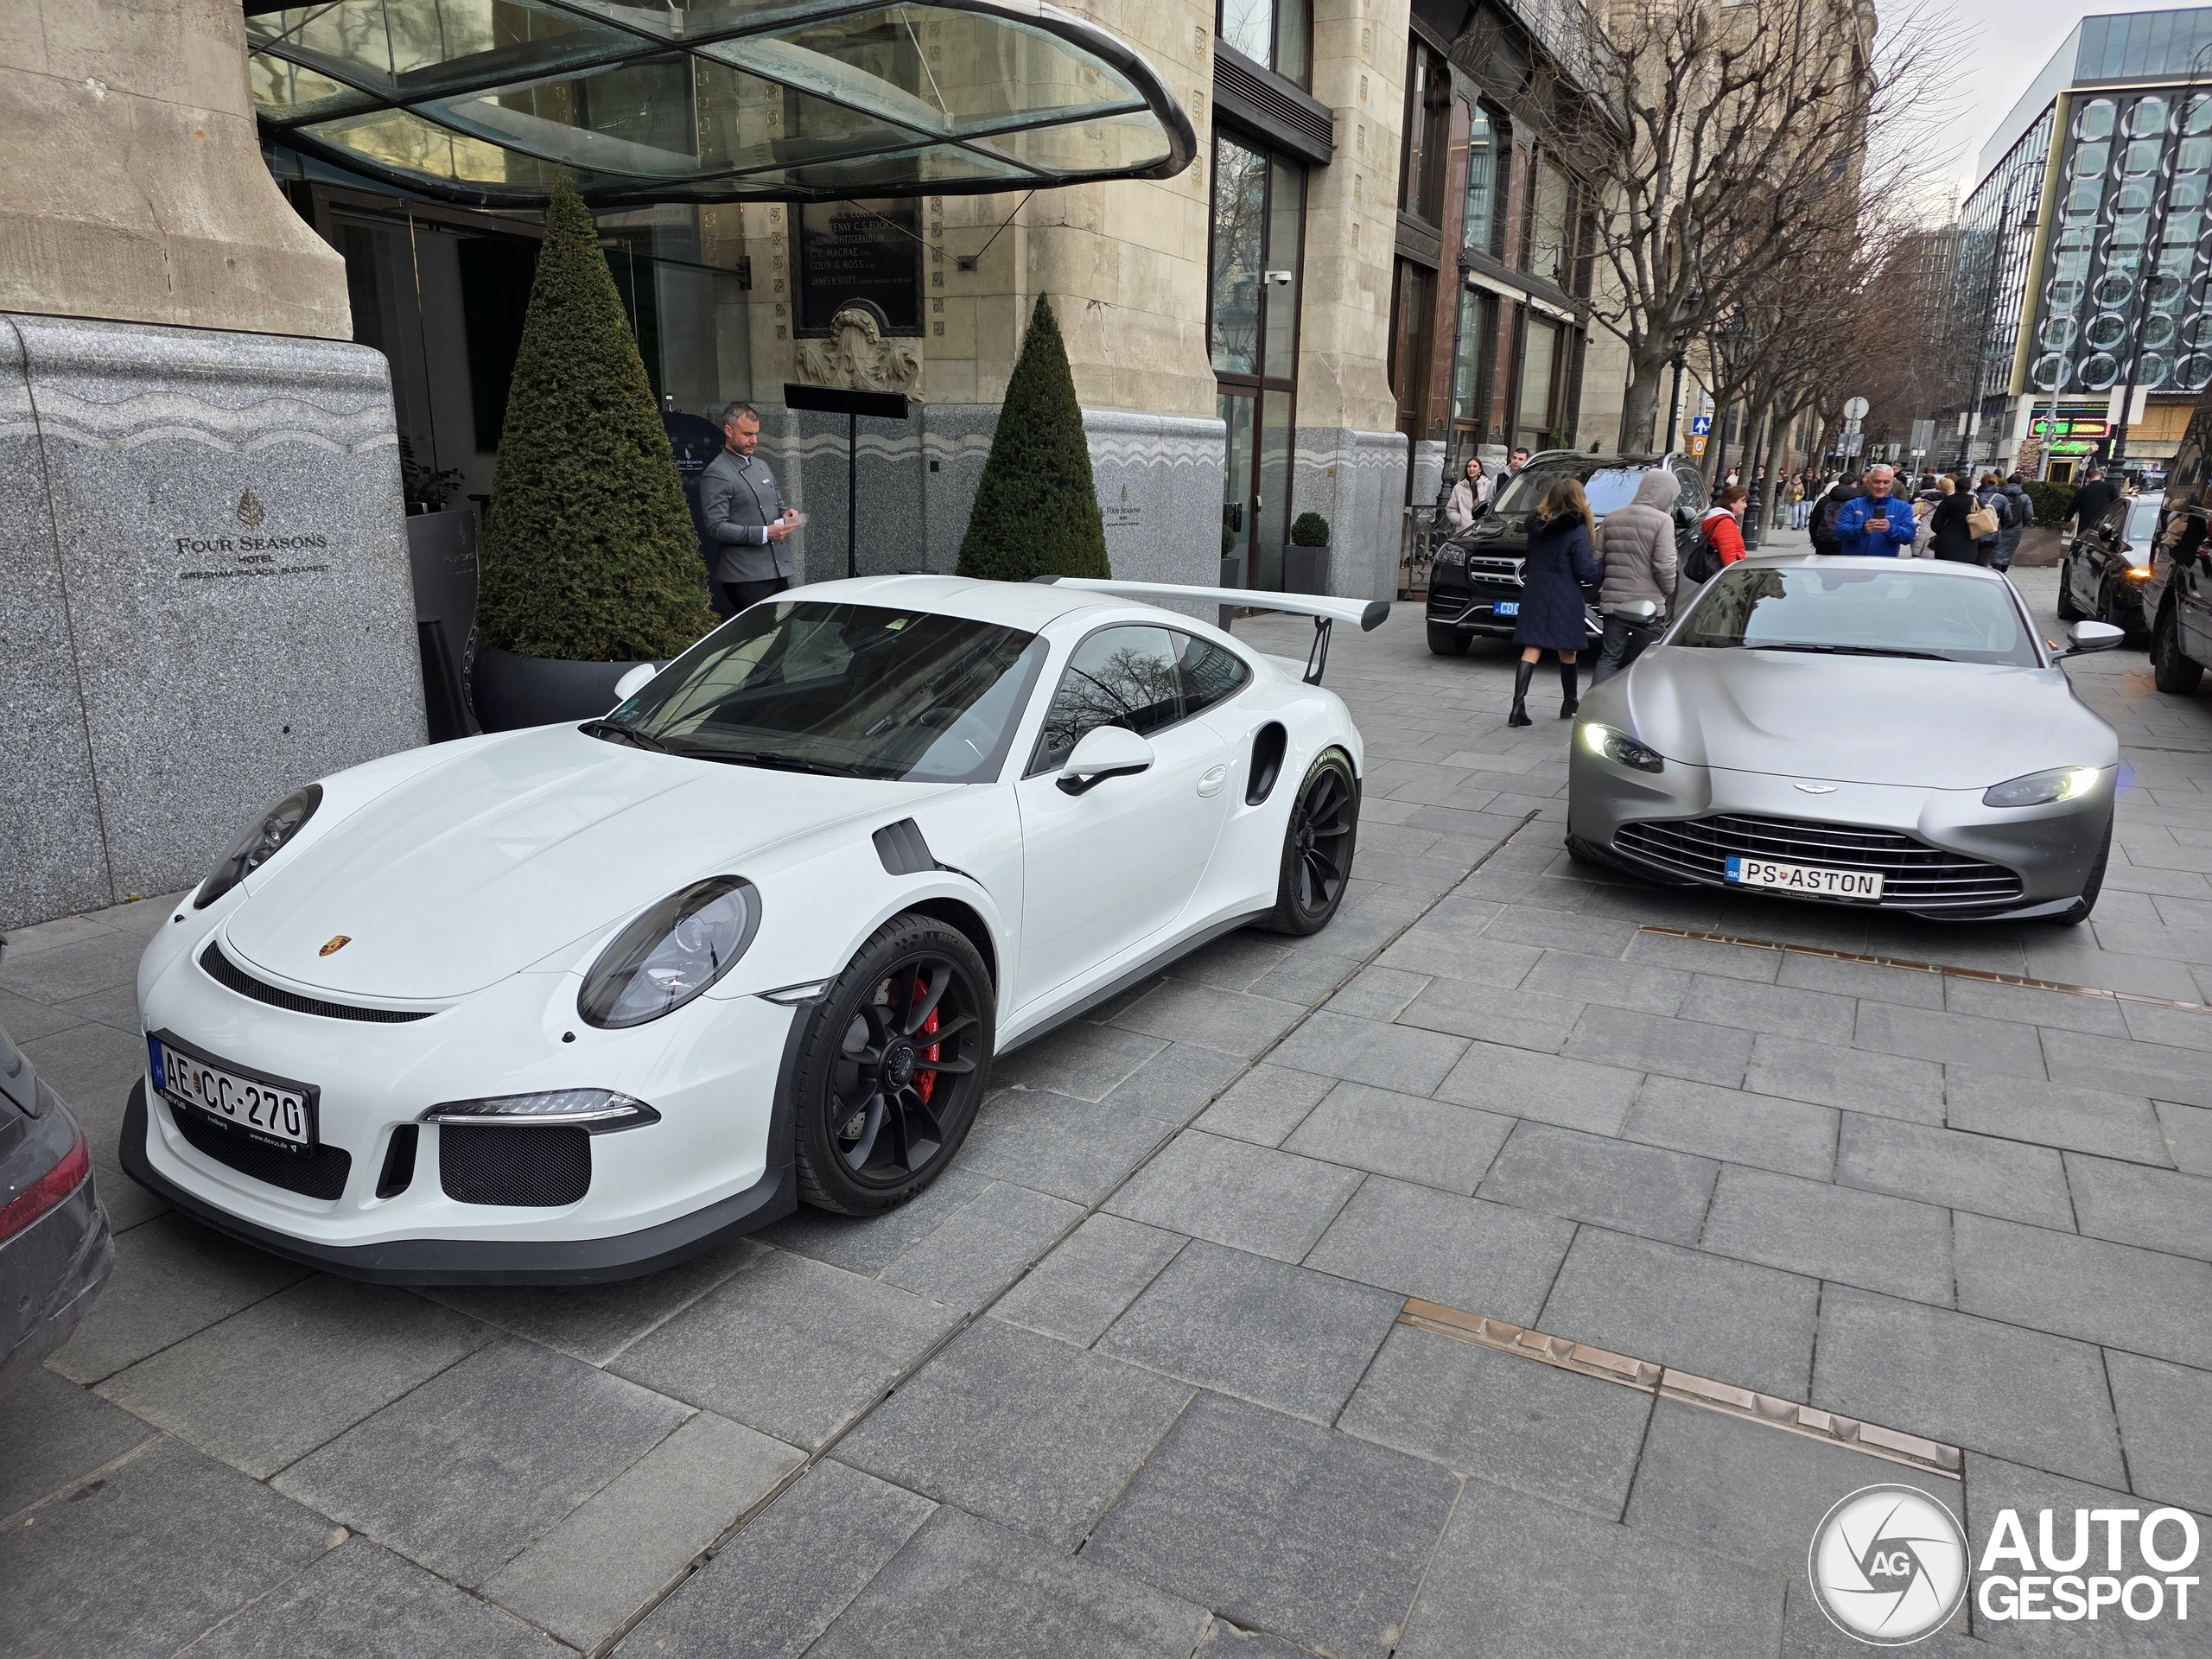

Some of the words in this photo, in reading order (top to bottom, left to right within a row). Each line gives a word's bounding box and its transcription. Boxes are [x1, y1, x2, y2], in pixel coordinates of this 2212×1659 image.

[810, 261, 831, 270] COLIN
[238, 555, 275, 563] HOTEL
[180, 570, 233, 581] GRESHAM
[281, 564, 330, 575] BUDAPEST
[1789, 868, 1873, 894] ASTON
[156, 1064, 163, 1080] H
[167, 1051, 194, 1099] AE
[164, 1092, 187, 1110] DEVUS
[207, 1115, 228, 1130] Freiburg
[250, 1133, 288, 1150] www.devus.de
